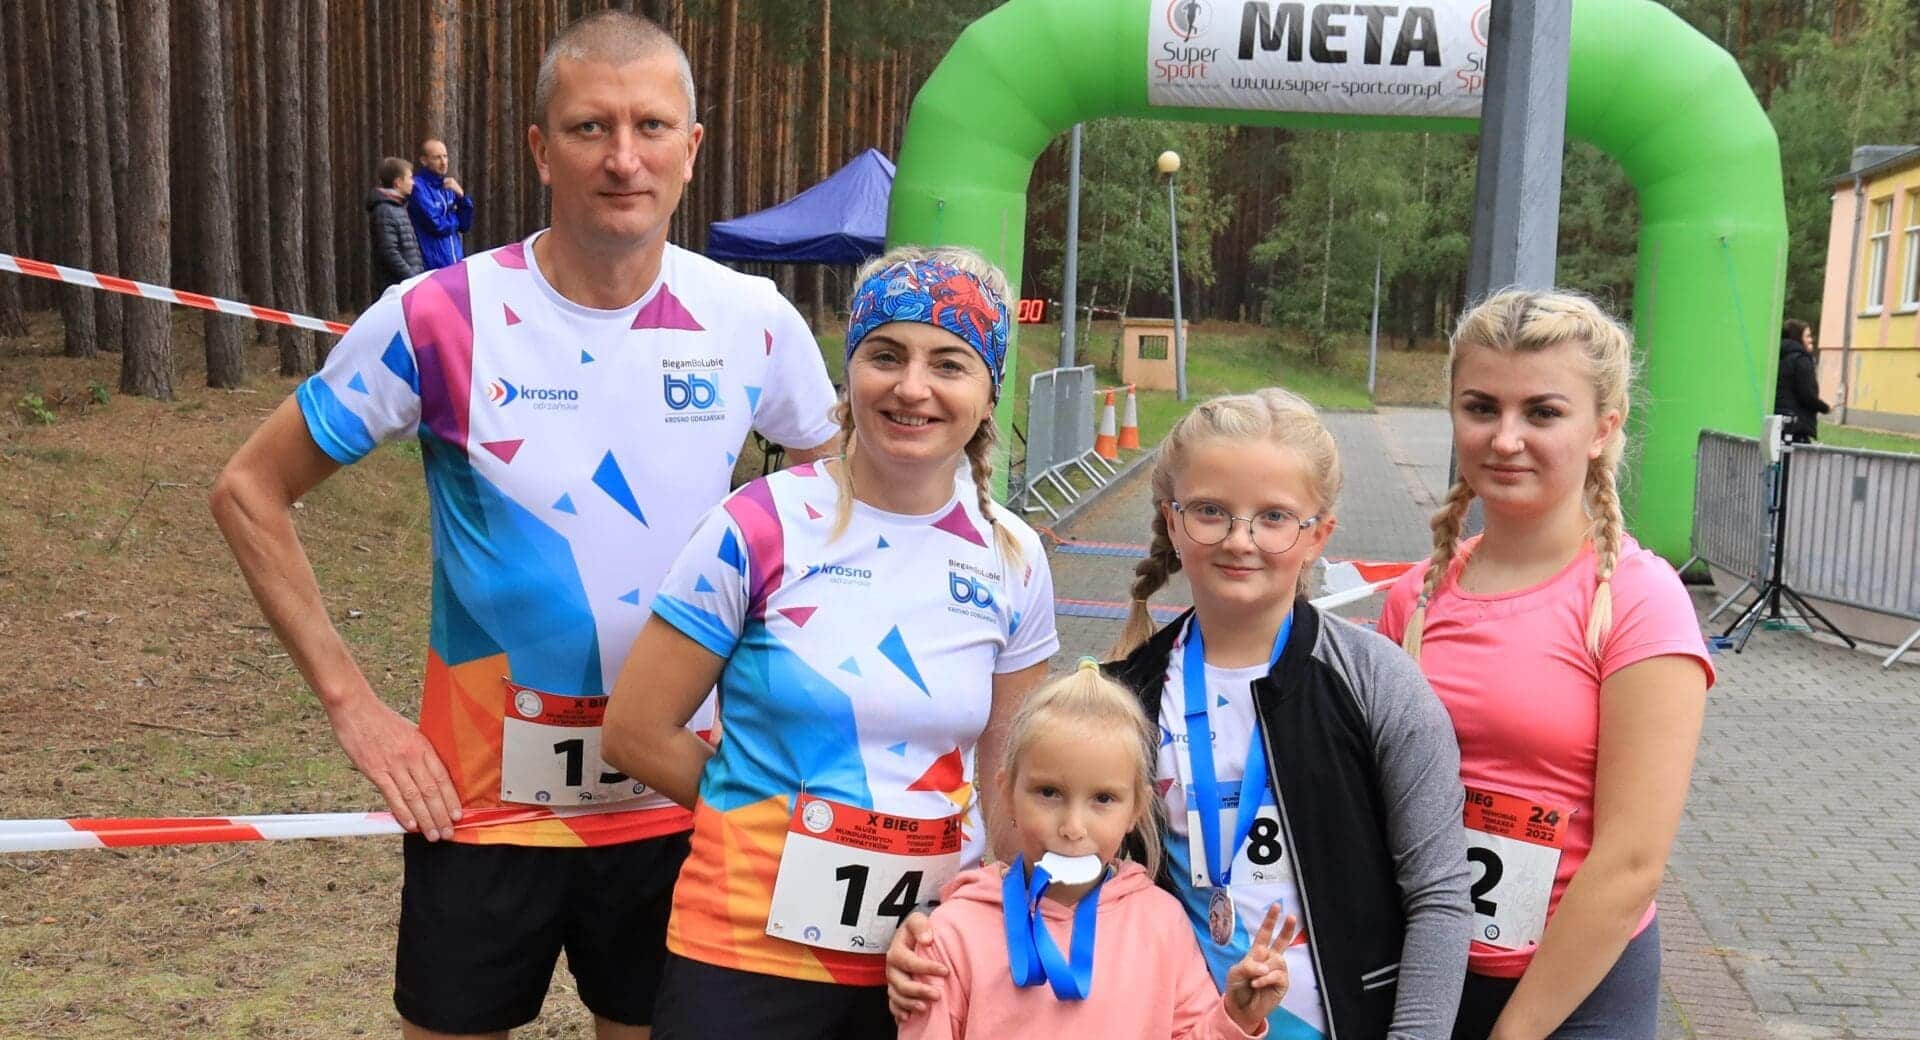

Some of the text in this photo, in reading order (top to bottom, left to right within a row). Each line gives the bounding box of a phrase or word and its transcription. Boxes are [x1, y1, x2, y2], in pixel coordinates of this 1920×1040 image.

[1238, 2, 1442, 67] META
[1163, 42, 1221, 65] Super
[1154, 59, 1207, 83] Sport
[1231, 77, 1443, 99] www.super-sport.com.pl
[520, 385, 578, 401] krosno
[820, 562, 872, 579] krosno
[867, 813, 919, 833] X BIEG
[1529, 806, 1560, 827] 24
[1247, 817, 1283, 866] 8
[1526, 828, 1555, 842] 2022
[835, 864, 924, 929] 14
